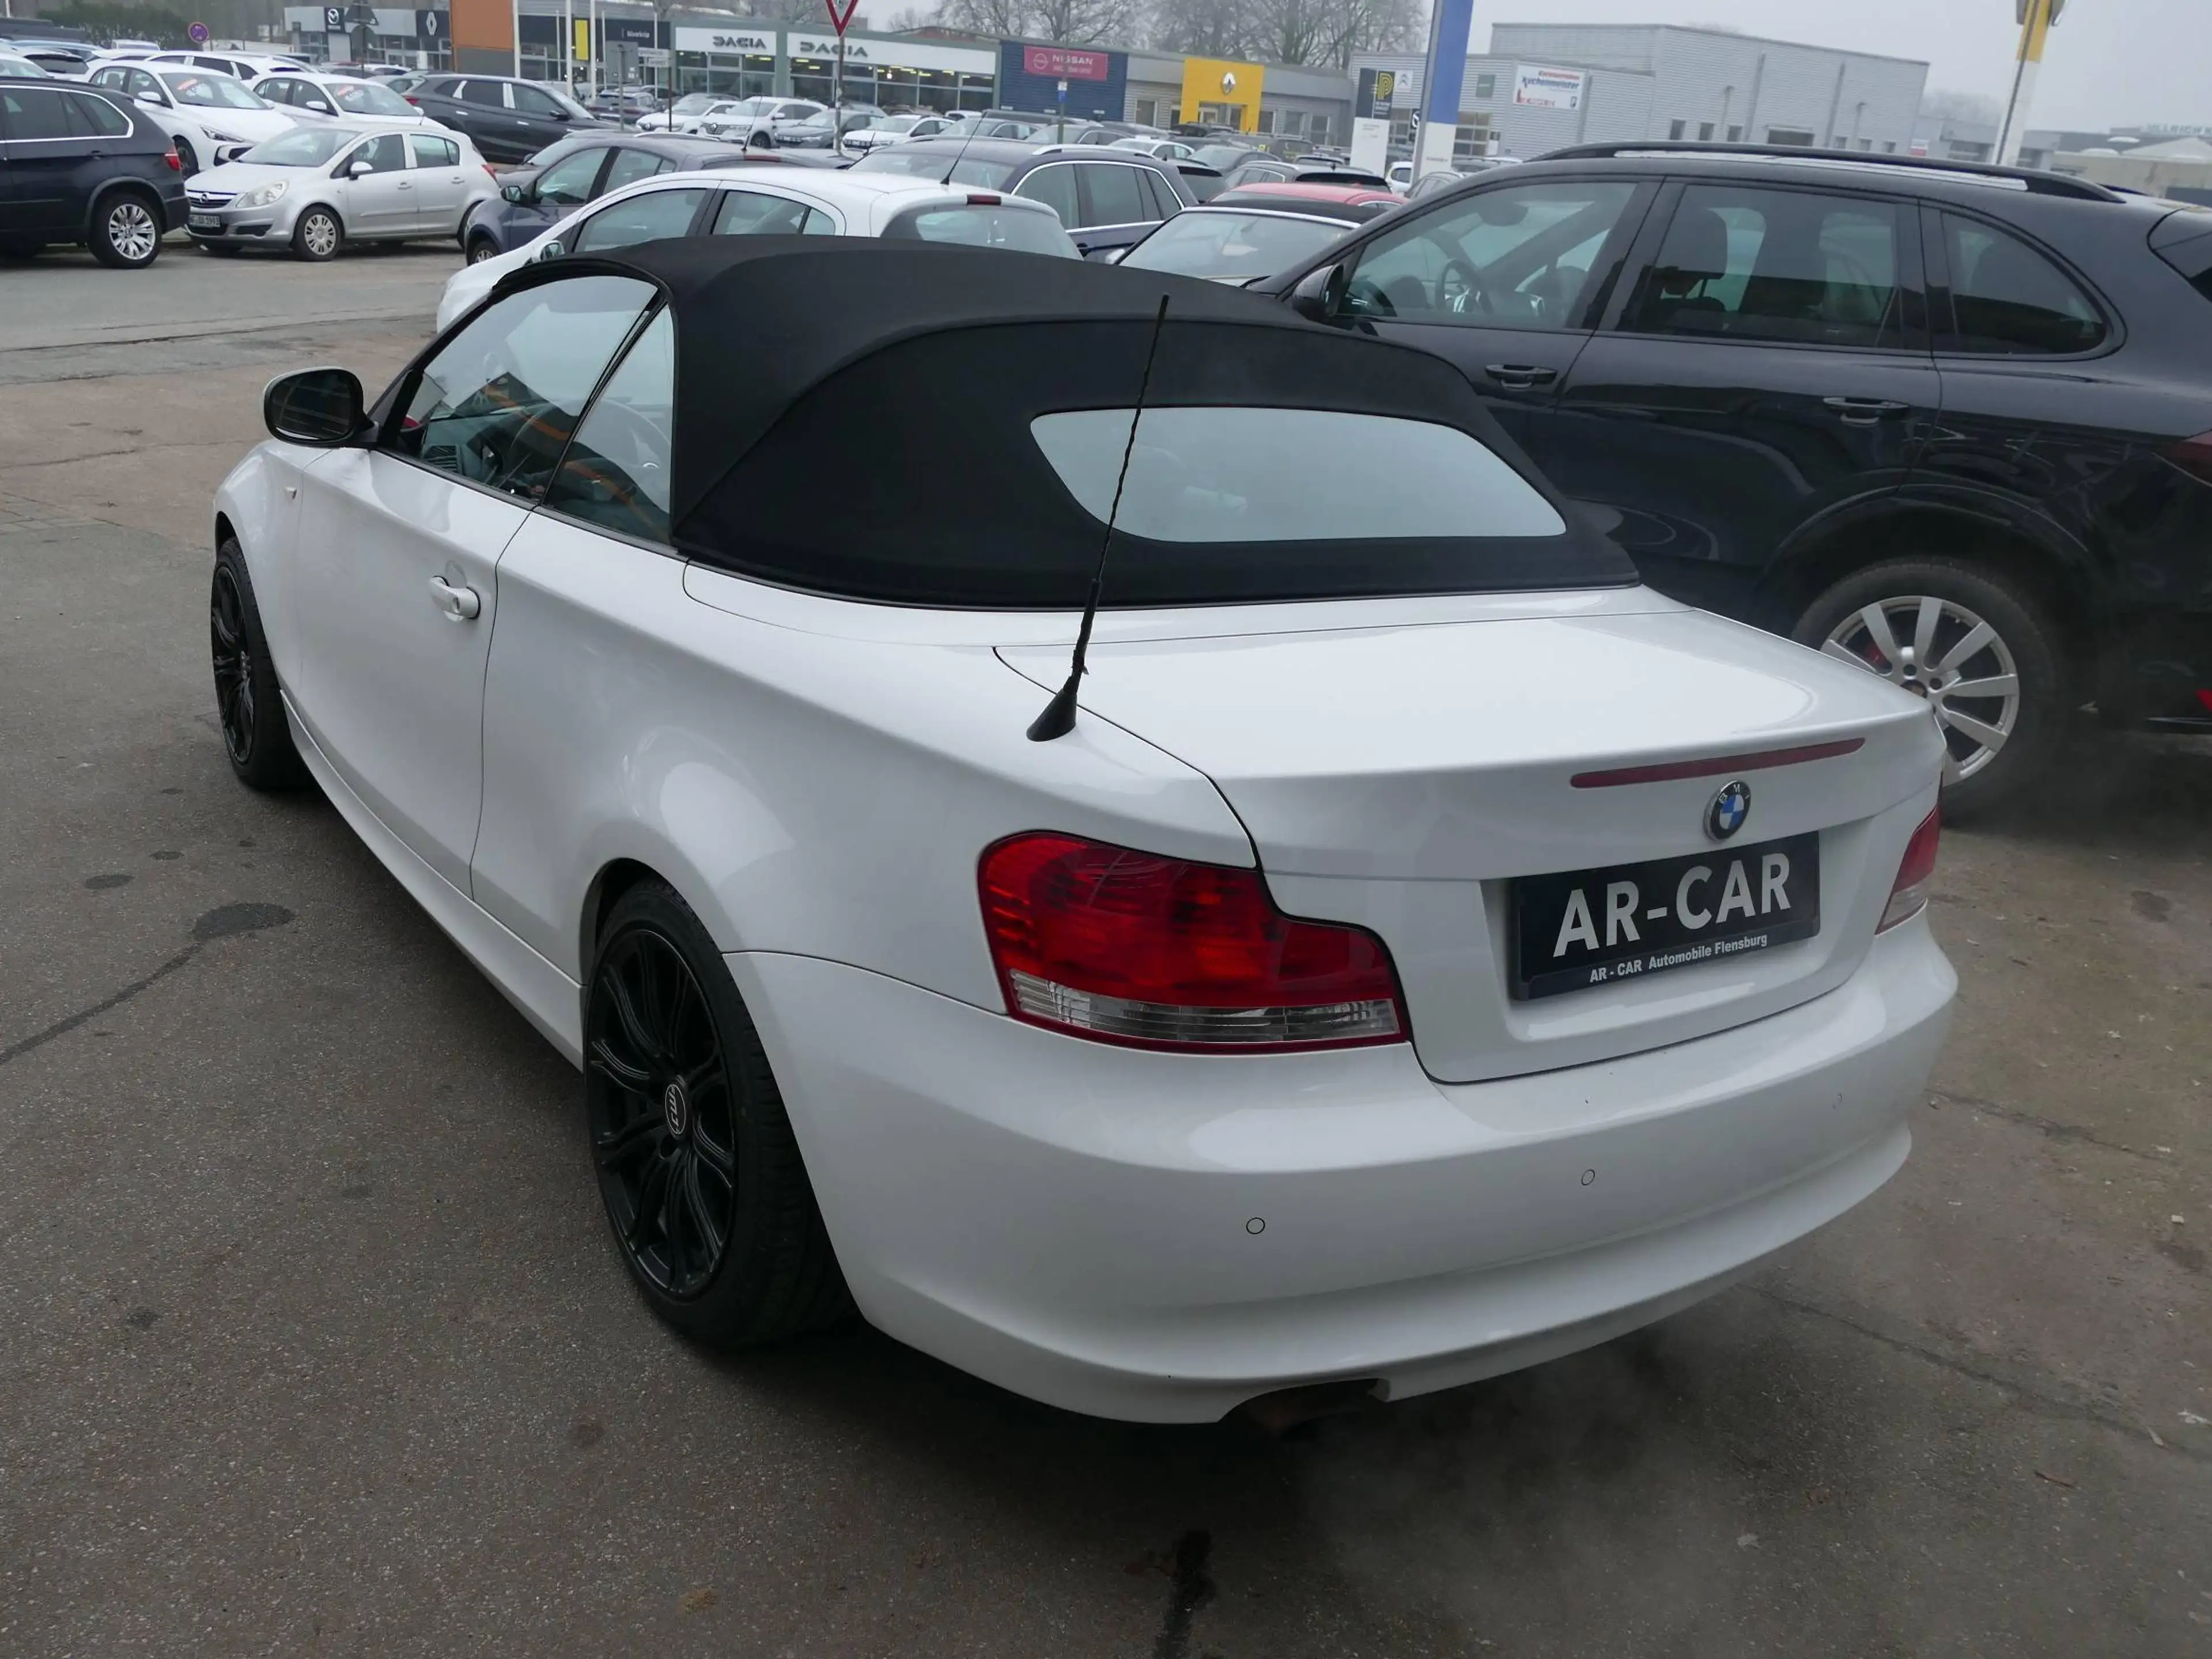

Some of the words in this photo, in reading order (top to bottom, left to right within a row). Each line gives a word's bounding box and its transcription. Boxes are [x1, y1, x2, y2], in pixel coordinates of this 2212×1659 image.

[712, 36, 766, 50] DACIA
[1553, 853, 1791, 957] AR-CAR
[1617, 959, 1642, 976] CAR
[1648, 946, 1712, 969] Automobile
[1715, 934, 1768, 955] Flensburg
